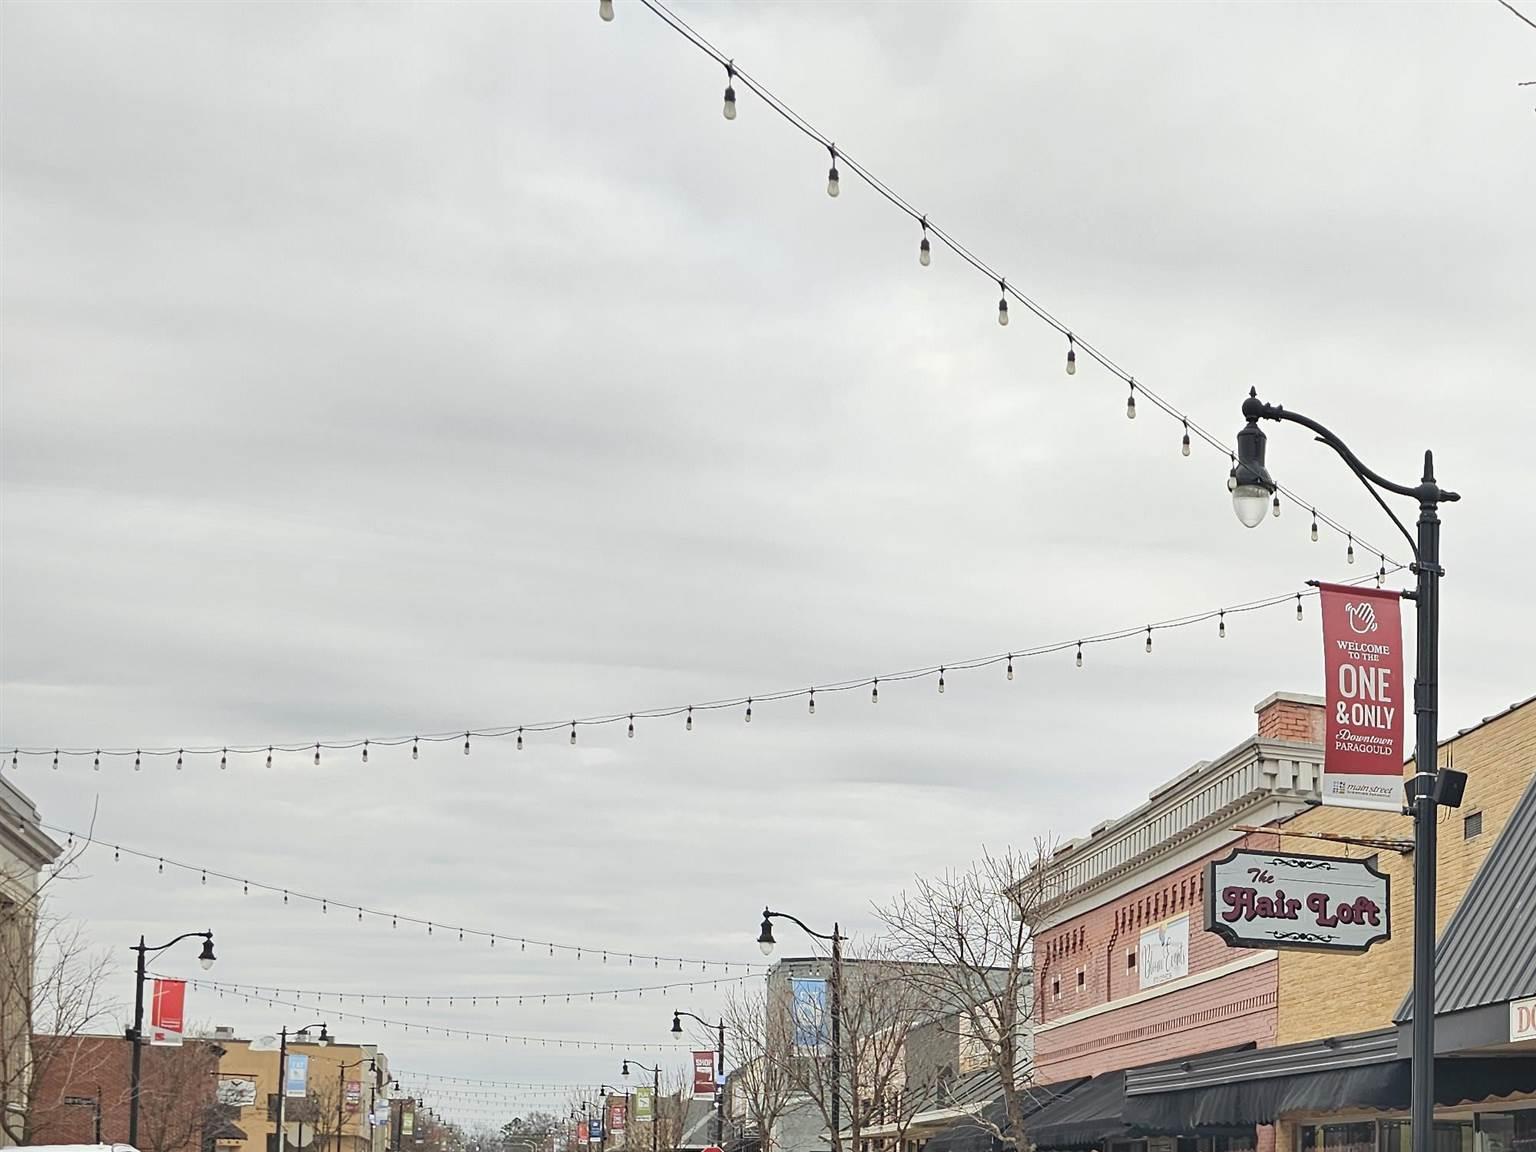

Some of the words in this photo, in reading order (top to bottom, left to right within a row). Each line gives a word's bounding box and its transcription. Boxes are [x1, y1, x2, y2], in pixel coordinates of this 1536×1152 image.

[1337, 640, 1390, 655] WELCOME
[1348, 651, 1360, 660] TO
[1362, 653, 1380, 661] THE
[1339, 664, 1392, 703] ONE
[1352, 703, 1395, 729] ONLY
[1336, 729, 1393, 746] Downtown
[1335, 741, 1393, 756] PARAGOULD
[1247, 868, 1275, 884] The
[1222, 886, 1302, 922] Hair
[1306, 893, 1381, 928] Loft
